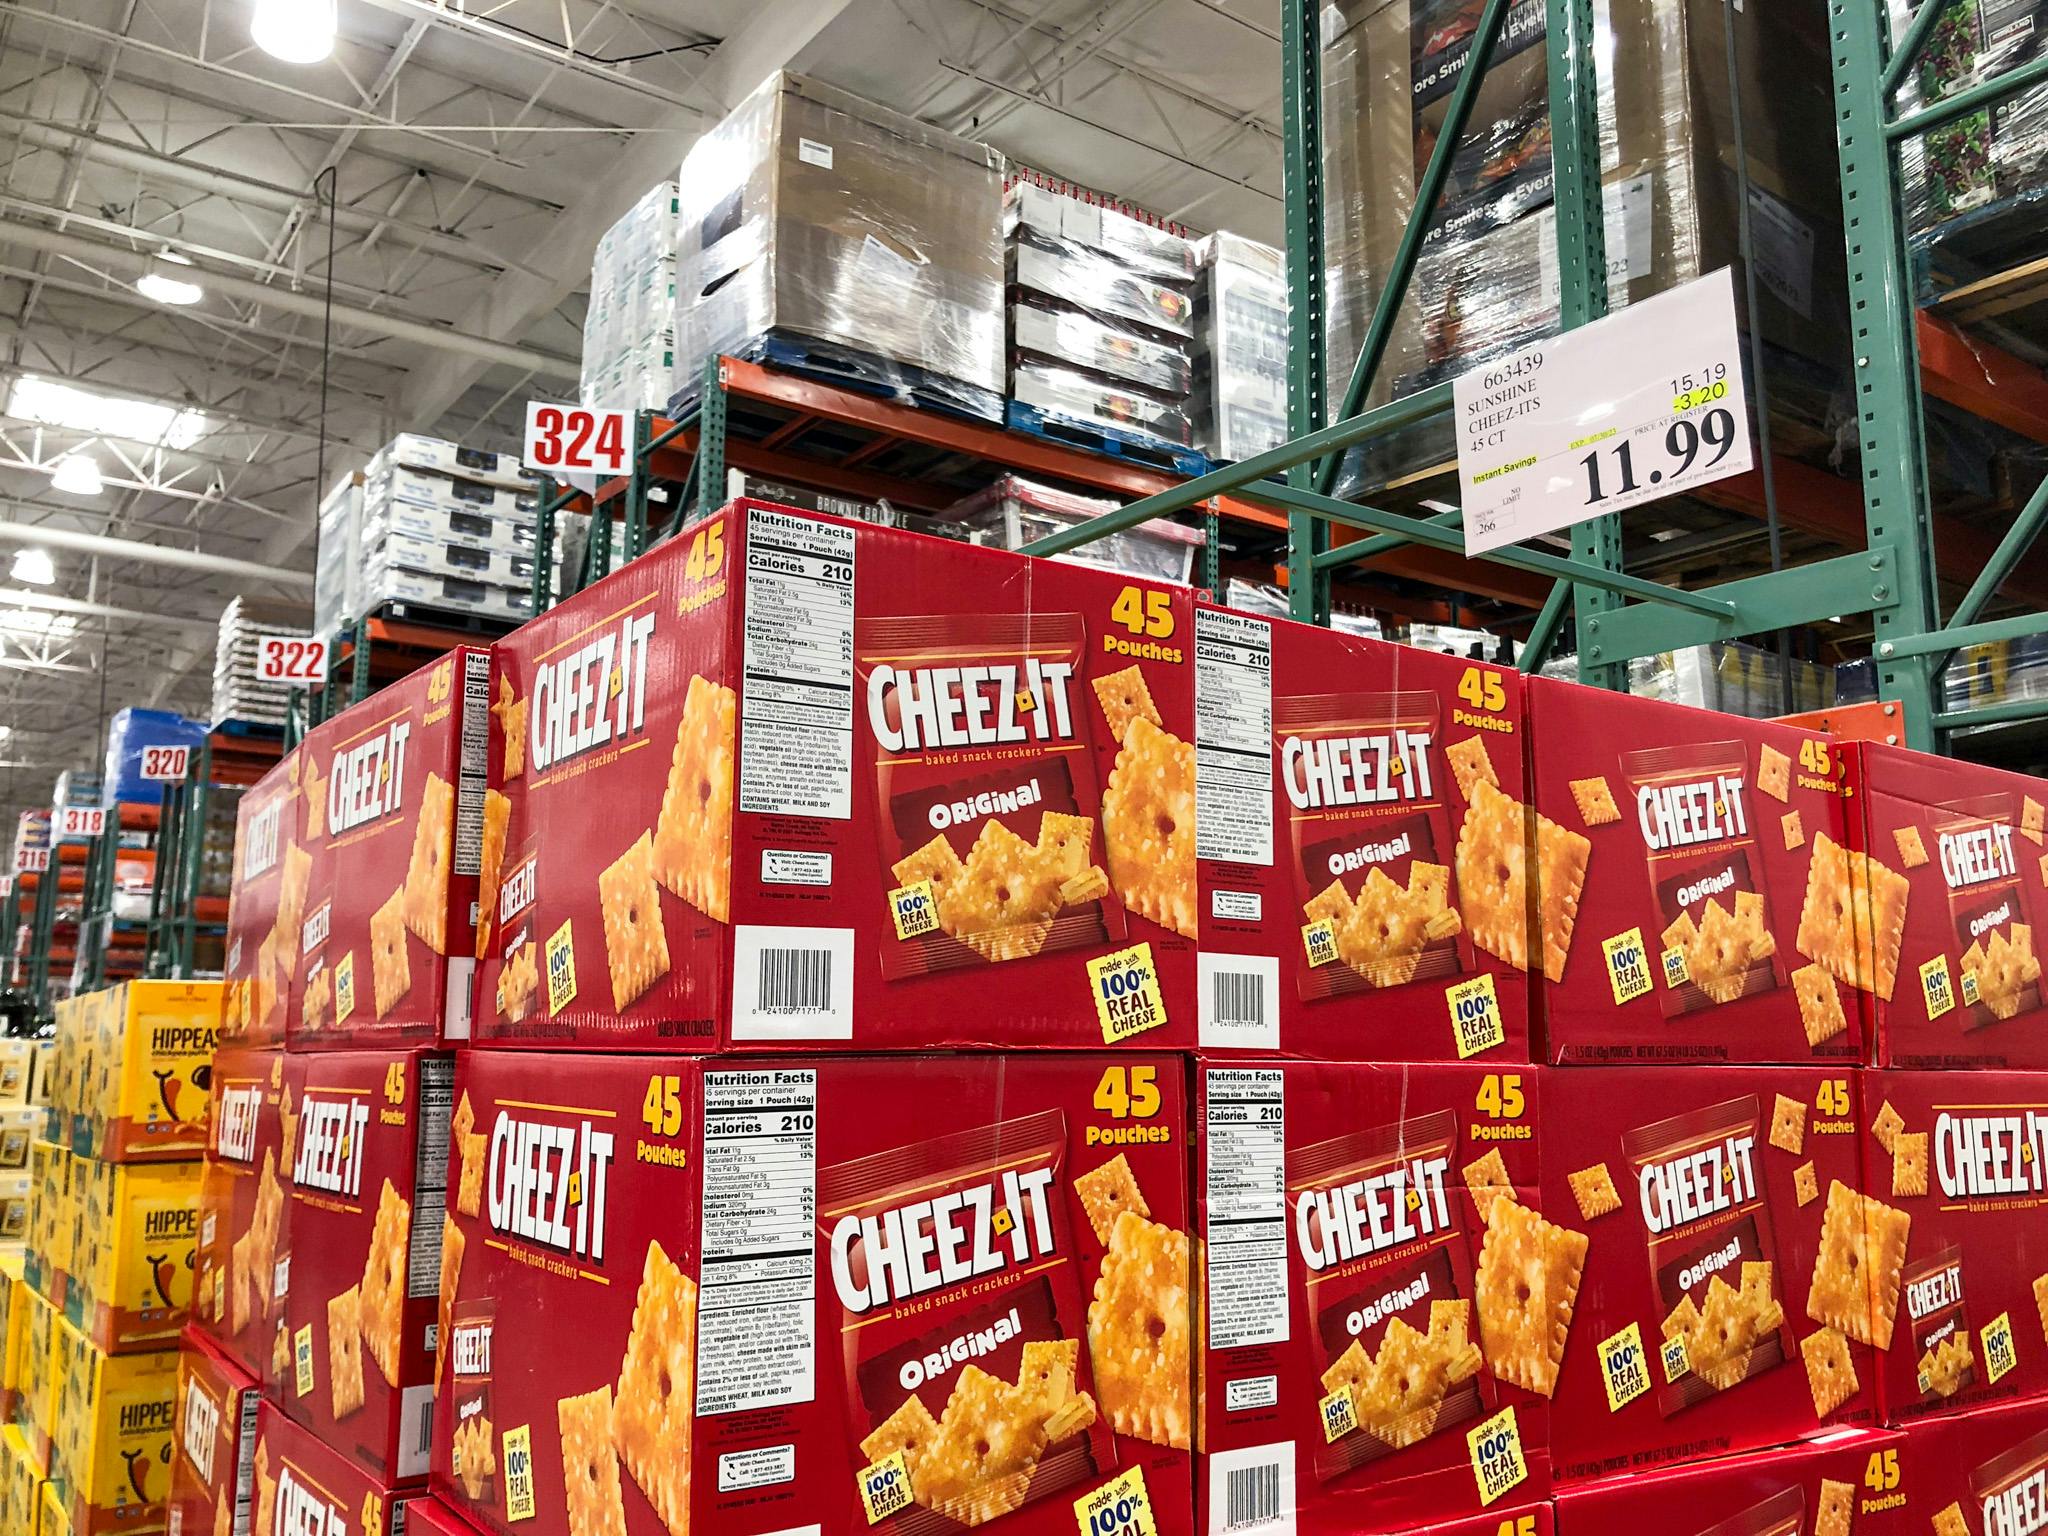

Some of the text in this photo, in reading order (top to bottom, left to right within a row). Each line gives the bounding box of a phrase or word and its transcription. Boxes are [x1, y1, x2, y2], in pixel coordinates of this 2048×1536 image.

[1484, 353, 1543, 389] 663439
[1670, 363, 1726, 395] 15.19
[1468, 379, 1536, 416] SUNSHINE
[1674, 382, 1725, 410] -3.20
[1469, 397, 1541, 433] CHEEZ-ITS
[1670, 406, 1708, 422] REGISTER
[534, 408, 625, 468] 324
[1471, 430, 1505, 452] 45 CT
[1473, 456, 1536, 483] Instant Savings
[1580, 408, 1735, 505] 11.99
[817, 495, 862, 517] BROWNIE
[750, 511, 853, 540] Nutrition Facts
[761, 526, 836, 545] servings container
[685, 519, 725, 583] 45
[750, 533, 779, 545] Serving
[782, 538, 797, 547] size
[809, 544, 833, 554] Pouch
[749, 554, 852, 581] Calories 210
[1111, 586, 1175, 639] 45
[1197, 611, 1269, 632] Nutrition Facts
[265, 641, 324, 678] 322
[1104, 635, 1183, 663] Pouches
[1197, 647, 1269, 666] Calories 210
[1458, 666, 1506, 712] 45
[1453, 708, 1514, 734] Pouches
[146, 750, 186, 775] 320
[926, 746, 1042, 766] baked snack crackers
[1799, 738, 1831, 776] 45
[67, 810, 102, 832] 318
[1324, 805, 1410, 821] baked snack crackers
[18, 851, 48, 868] 316
[1099, 958, 1122, 976] made
[1612, 947, 1642, 971] 100%
[551, 965, 572, 990] REAL
[1101, 967, 1151, 999] 100%
[1615, 963, 1645, 987] REAL
[1620, 979, 1647, 998] CHEESE
[1107, 989, 1154, 1020] REAL
[1456, 995, 1493, 1021] 100%
[1112, 1008, 1157, 1034] CHEESE
[1461, 1013, 1495, 1039] REAL
[1465, 1029, 1497, 1051] CHEESE
[384, 1062, 405, 1105] 45
[705, 1073, 813, 1086] Nutrition Facts
[1208, 1071, 1281, 1081] Nutrition Facts
[715, 1088, 746, 1096] servings
[794, 1096, 814, 1104] (42g)
[1093, 1065, 1161, 1118] 45
[1475, 1074, 1525, 1118] 45
[1816, 1079, 1850, 1116] 45
[642, 1075, 682, 1137] 45
[1209, 1107, 1282, 1121] Calories 210
[705, 1115, 813, 1134] Calories 210
[1086, 1124, 1170, 1147] Pouches
[1471, 1123, 1531, 1140] Pouches
[1813, 1120, 1854, 1134] Pouches
[637, 1139, 686, 1168] Pouches
[145, 1209, 197, 1233] HIPPE
[720, 1209, 765, 1218] Carbohydrate
[547, 1256, 578, 1280] crackers
[1341, 1242, 1428, 1278] baked snack crackers
[895, 1271, 1021, 1320] baked snack crackers
[1987, 1330, 2009, 1353] 100%
[1607, 1343, 1640, 1373] 100%
[1990, 1347, 2011, 1366] REAL
[1611, 1366, 1642, 1392] REAL
[1615, 1378, 1645, 1403] CHEESE
[120, 1401, 172, 1427] HIPPE
[1477, 1429, 1514, 1464] 100%
[1482, 1450, 1517, 1484] REAL
[1865, 1449, 1901, 1492] 45
[509, 1475, 529, 1497] REAL
[1487, 1466, 1520, 1496] CHEESE
[1088, 1490, 1112, 1514] made
[1862, 1492, 1907, 1515] Pouches
